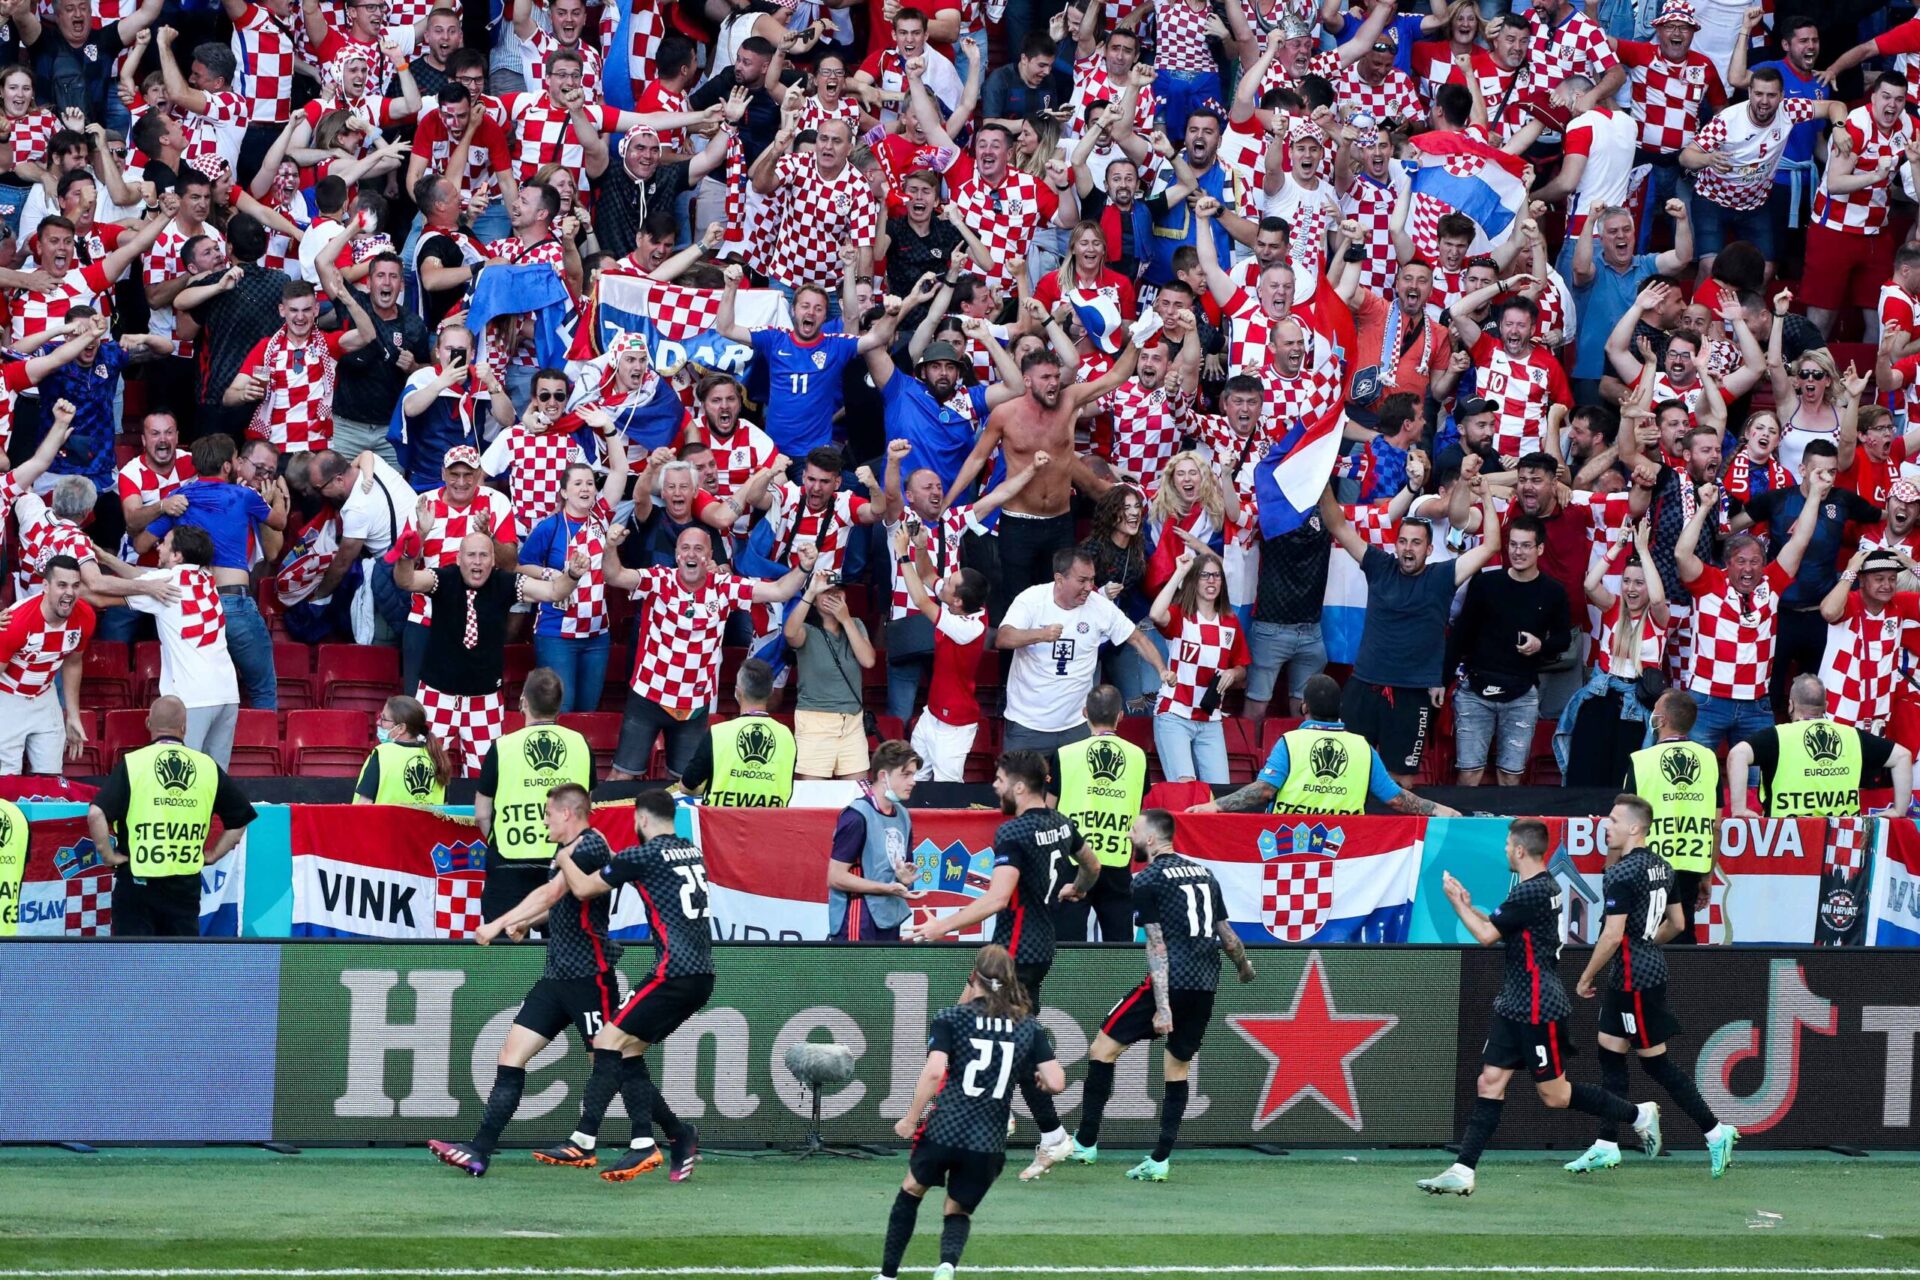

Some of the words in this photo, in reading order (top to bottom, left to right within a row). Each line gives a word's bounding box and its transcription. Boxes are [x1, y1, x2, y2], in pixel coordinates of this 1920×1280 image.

[1759, 143, 1767, 159] 5
[603, 320, 754, 377] ZDAR
[790, 373, 808, 394] 11
[1489, 373, 1504, 393] 10
[1182, 642, 1199, 662] 17
[1417, 710, 1429, 738] POLO
[1804, 767, 1850, 777] EURO2020
[1776, 790, 1859, 809] STEWAR
[672, 864, 711, 920] 25
[1179, 884, 1213, 938] 11
[584, 1011, 604, 1035] 15
[1621, 1011, 1638, 1034] 18
[1534, 1045, 1549, 1067] 9
[962, 1038, 1015, 1099] 21
